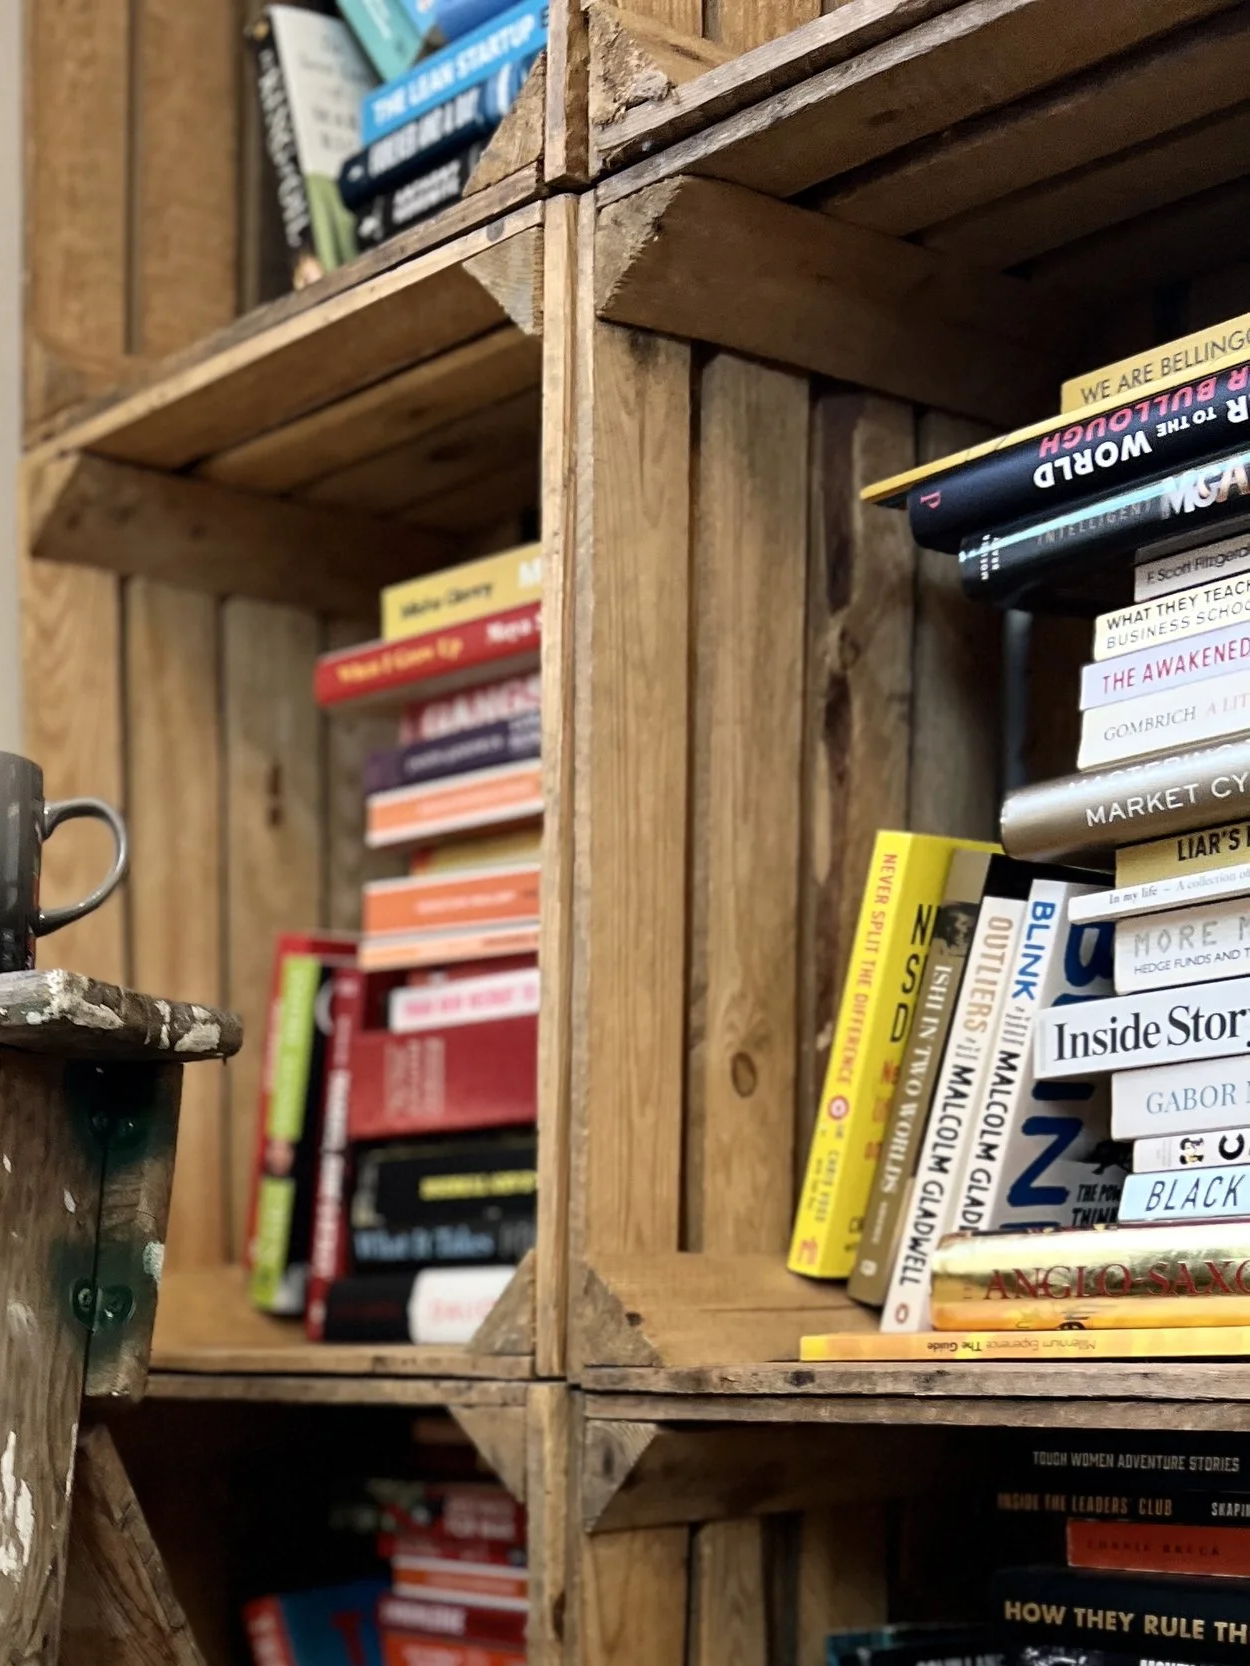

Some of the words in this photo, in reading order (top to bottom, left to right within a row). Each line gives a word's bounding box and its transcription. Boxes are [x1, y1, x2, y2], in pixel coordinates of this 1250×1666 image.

[454, 13, 536, 84] STARTUP
[1080, 382, 1111, 405] WE
[1116, 362, 1154, 393] ARE
[1037, 378, 1218, 459] BULLOUGH
[1155, 415, 1192, 438] THE
[1192, 406, 1218, 424] TO
[1031, 430, 1153, 489] WORLD
[1157, 562, 1192, 582] Scott
[1194, 546, 1250, 571] Fitzgera
[1105, 607, 1151, 631] WHAT
[1156, 593, 1199, 617] THEY
[1106, 615, 1191, 649] BUSINESS
[1102, 666, 1137, 694] THE
[1141, 636, 1250, 684] AWAKENED
[1102, 705, 1197, 741] GOMBRICH
[1085, 783, 1201, 827] MARKET
[1176, 828, 1241, 862] LIAR'S
[875, 852, 899, 905] NEVER
[863, 906, 887, 955] SPLIT
[1010, 900, 1057, 1002] BLINK
[1134, 919, 1220, 958] MORE
[854, 959, 877, 990] THE
[962, 916, 1015, 1034] OUTLIERS
[1134, 957, 1172, 976] HEDGE
[1214, 948, 1242, 963] AND
[837, 991, 870, 1086] DIFFERENCE
[1054, 1012, 1162, 1063] Inside
[927, 1063, 976, 1175] MALCOLM
[976, 1050, 1021, 1163] MALCOLM
[1146, 1083, 1236, 1115] GABOR
[1145, 1174, 1246, 1213] BLACK
[898, 1179, 945, 1287] GLADWELL
[927, 1341, 959, 1353] Guide
[962, 1341, 983, 1352] The
[1032, 1451, 1068, 1467] TOUGH
[1070, 1452, 1114, 1468] WOMEN
[1117, 1455, 1186, 1471] ADVENTURE
[1188, 1456, 1240, 1473] STORIES
[1138, 1498, 1173, 1517] CLUB
[1004, 1599, 1067, 1626] HOW
[1073, 1608, 1135, 1633] THEY
[1143, 1615, 1206, 1640] RULE
[1213, 1621, 1250, 1645] TH
